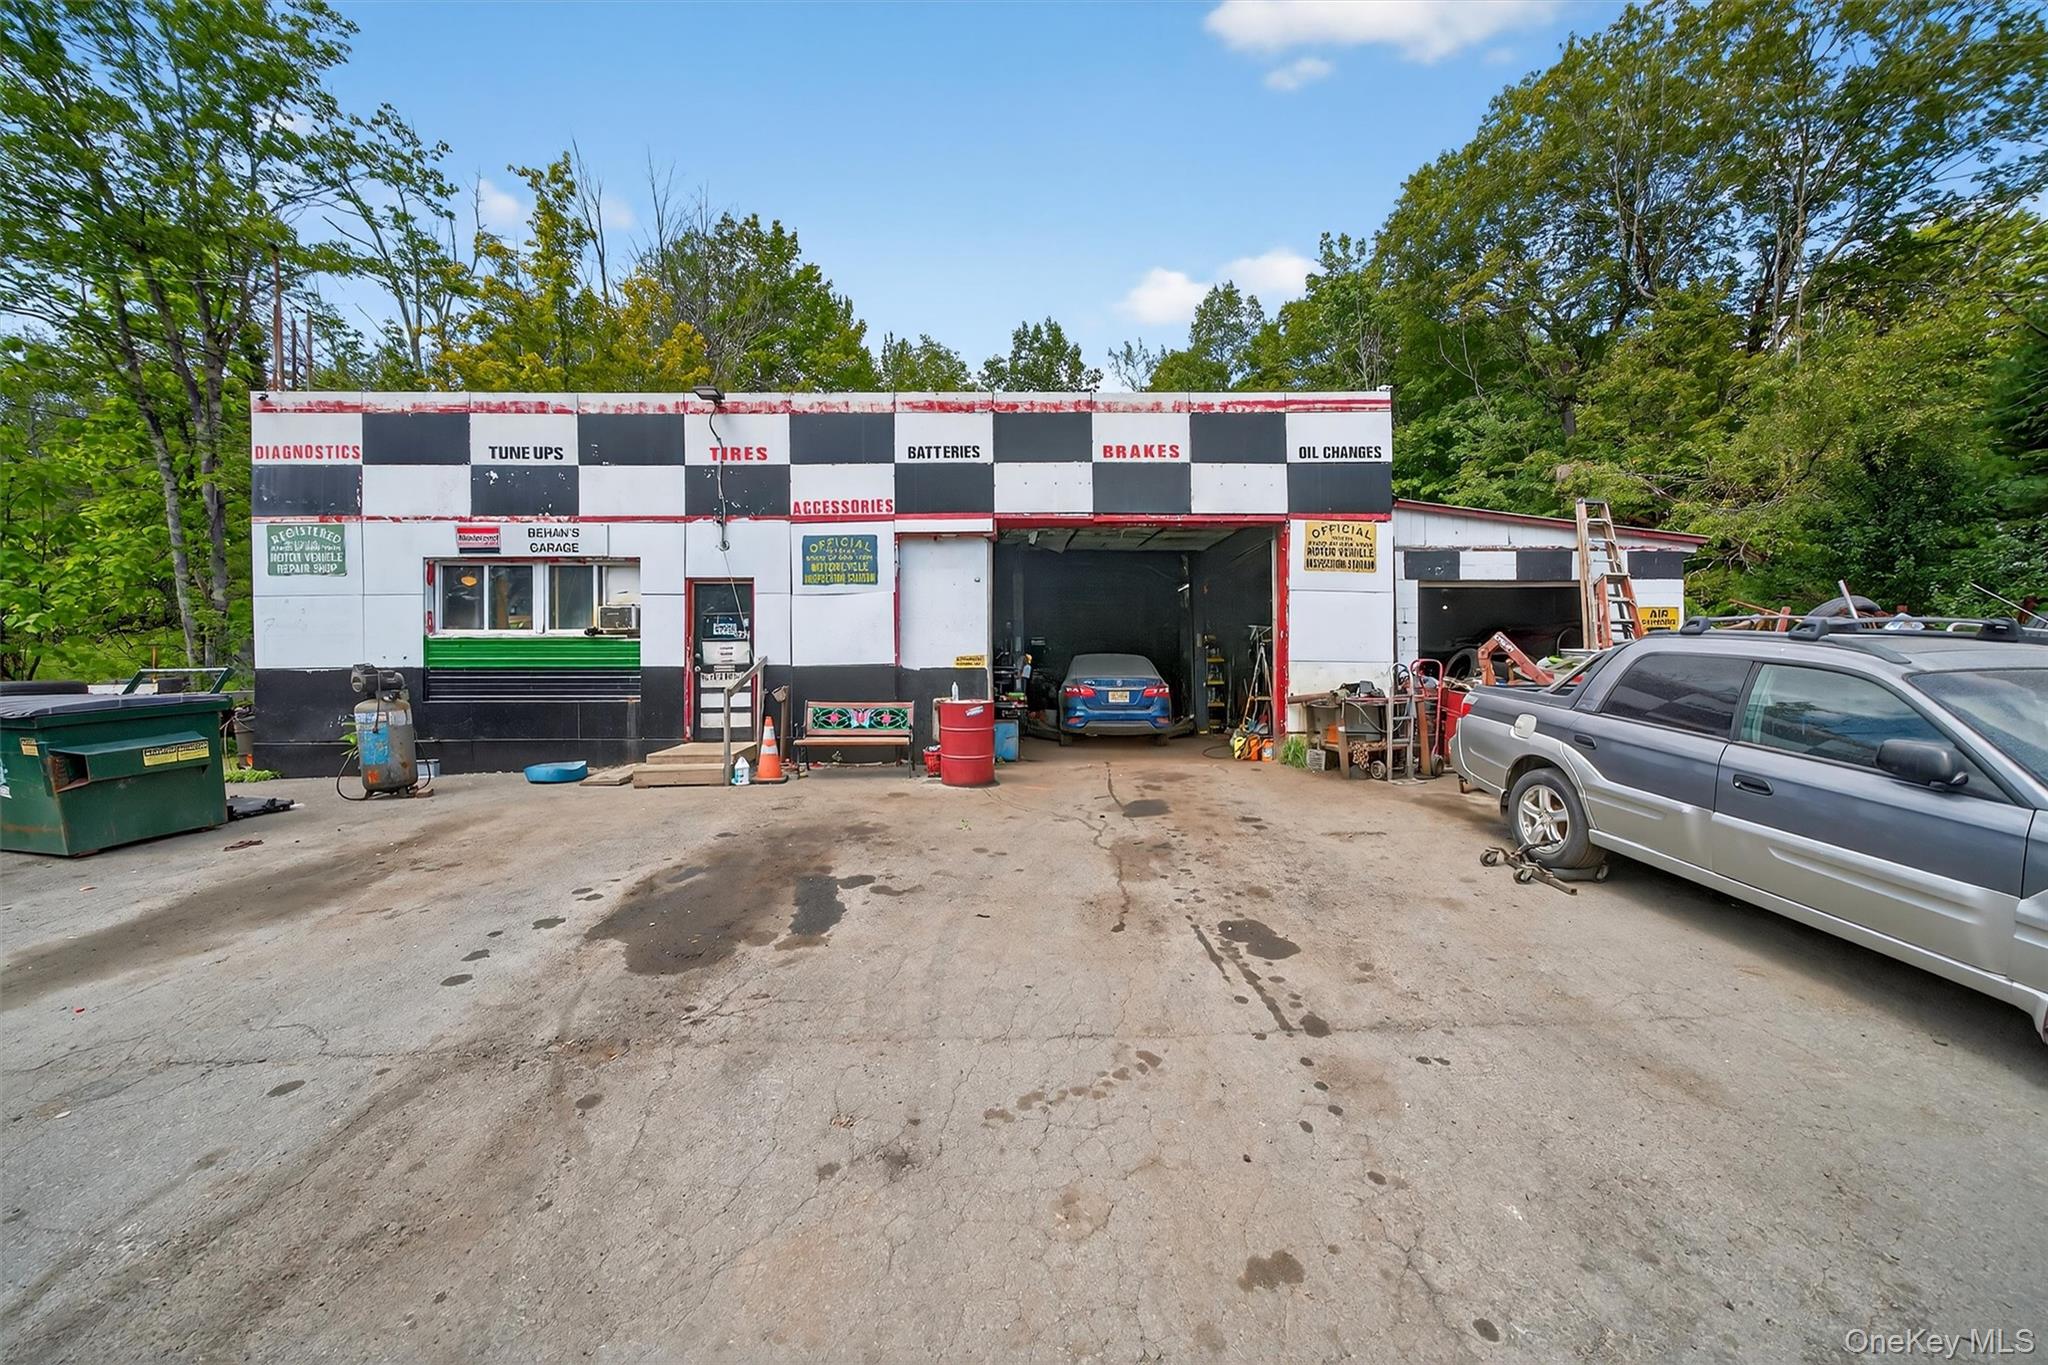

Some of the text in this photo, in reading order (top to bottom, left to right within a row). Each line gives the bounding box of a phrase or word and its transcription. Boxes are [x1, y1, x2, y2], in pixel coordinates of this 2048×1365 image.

[255, 444, 361, 460] DIAGNOSTICS
[488, 445, 564, 461] TUNE UPS
[709, 447, 768, 461] TIRES
[907, 445, 981, 460] BATTERIES
[1102, 444, 1181, 460] BRAKES
[1298, 445, 1382, 460] OIL CHANGES
[792, 498, 894, 516] ACCESSORIES
[270, 526, 342, 544] REGISTERED
[527, 527, 580, 539] BEHAN'S
[1311, 523, 1372, 541] OFFICIAL
[529, 542, 580, 554] GARAGE
[809, 536, 872, 553] OFFICIAL
[276, 563, 338, 575] REPAIR SHOP
[1649, 609, 1669, 619] AIR
